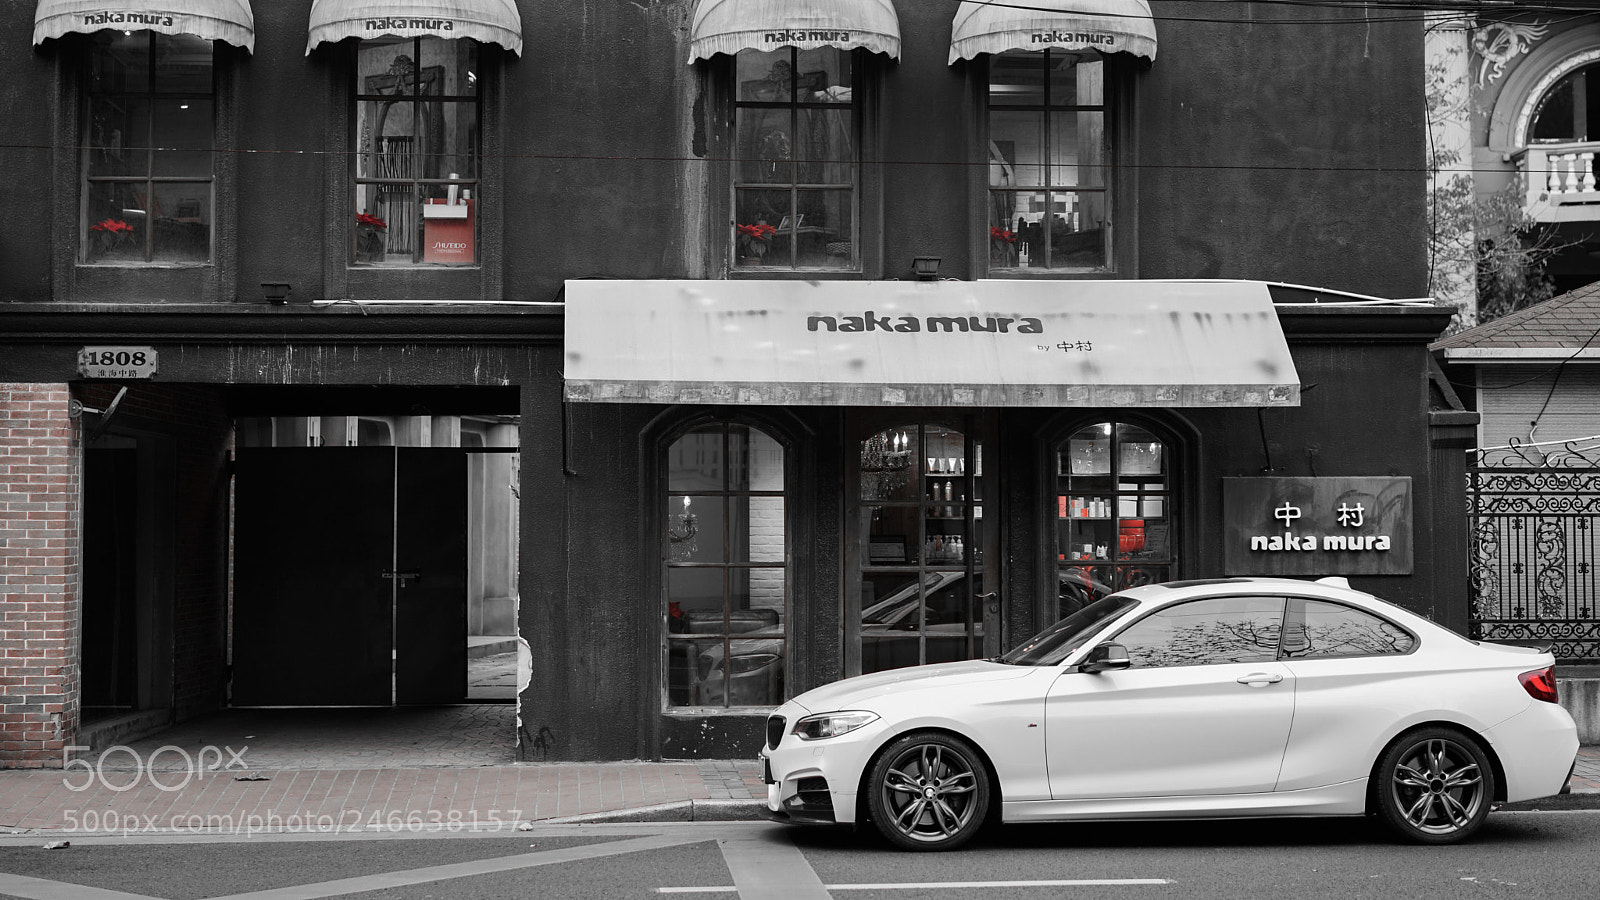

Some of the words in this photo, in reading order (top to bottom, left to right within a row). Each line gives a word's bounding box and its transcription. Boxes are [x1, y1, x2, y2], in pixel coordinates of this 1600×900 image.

[1037, 344, 1050, 352] by
[1056, 340, 1093, 352] 中村
[88, 351, 146, 366] 1808
